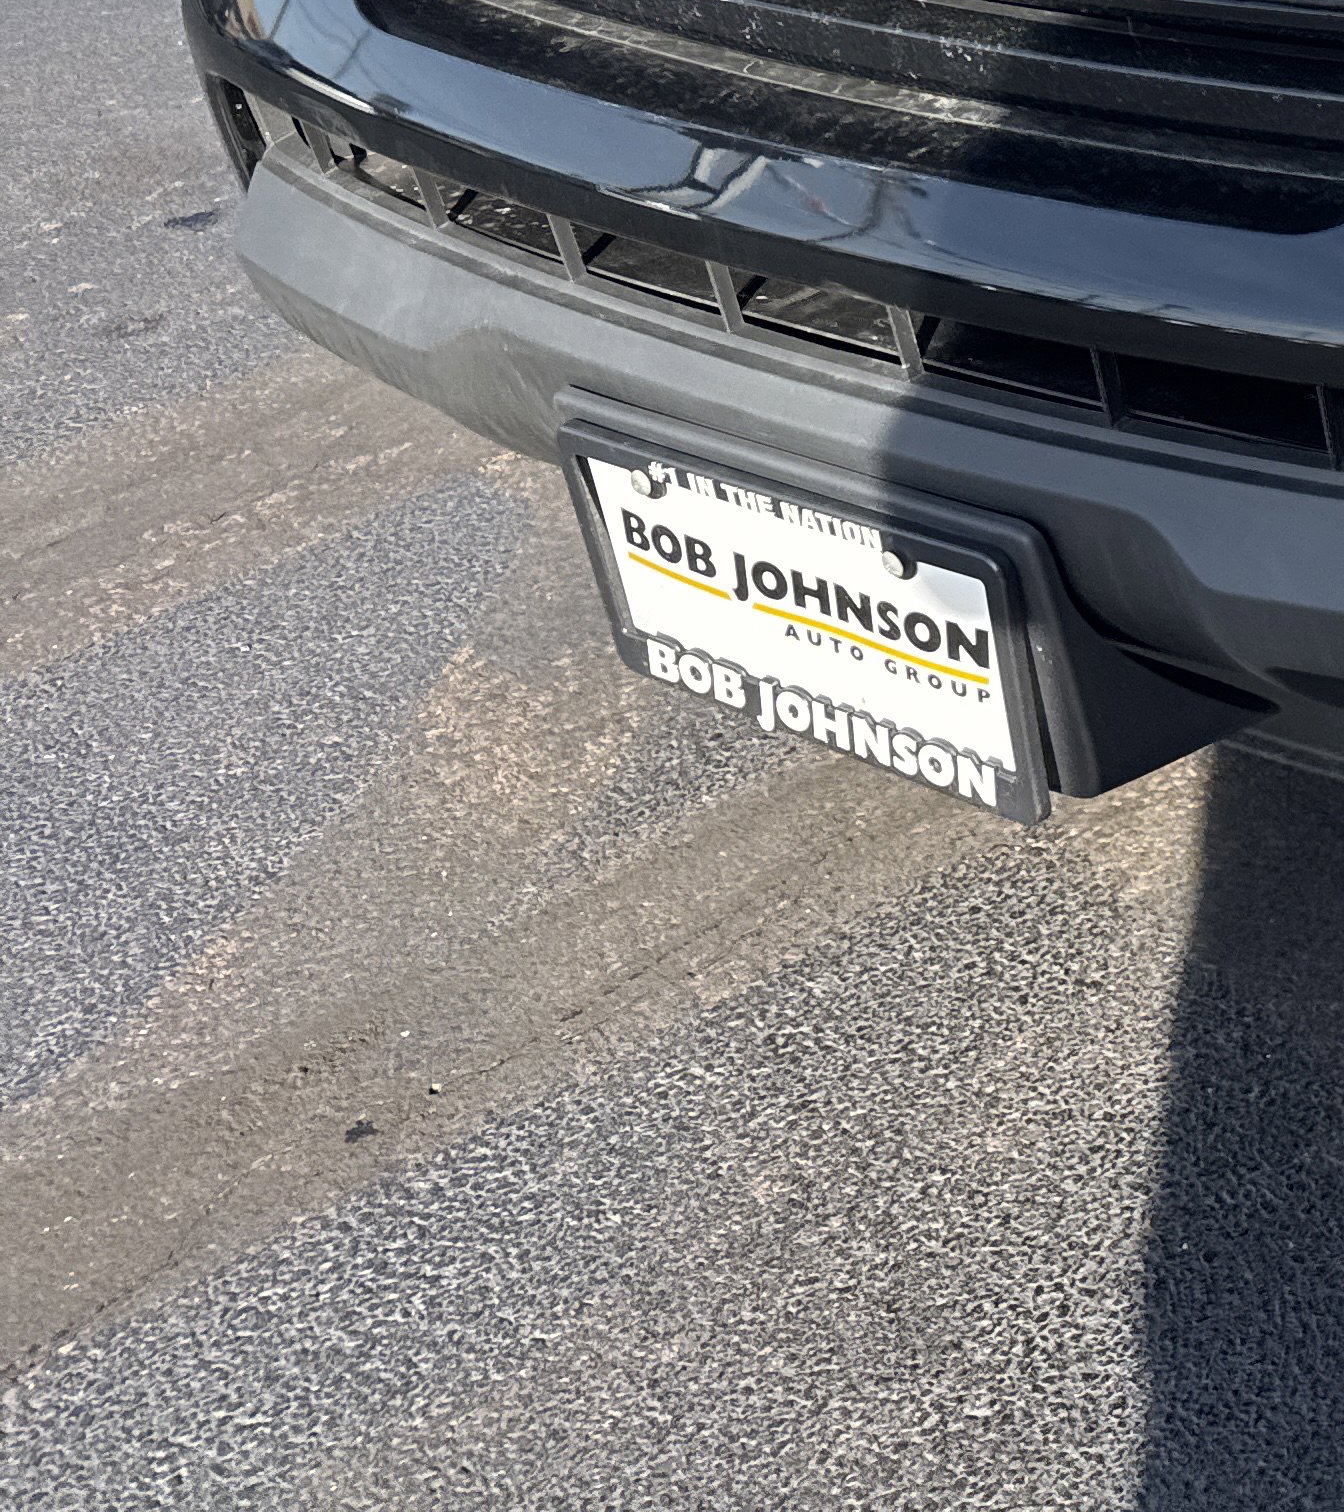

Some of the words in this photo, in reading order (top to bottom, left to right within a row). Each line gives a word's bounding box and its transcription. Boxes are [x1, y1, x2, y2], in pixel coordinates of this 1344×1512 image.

[686, 472, 716, 497] IN
[719, 482, 775, 514] THE
[779, 501, 883, 551] NATION
[621, 507, 717, 578] BOB
[732, 551, 990, 669] JOHNSON
[646, 637, 747, 709] BOB
[757, 679, 998, 808] JOHNSON
[784, 623, 864, 661] AUTO
[884, 657, 991, 704] GROUP
